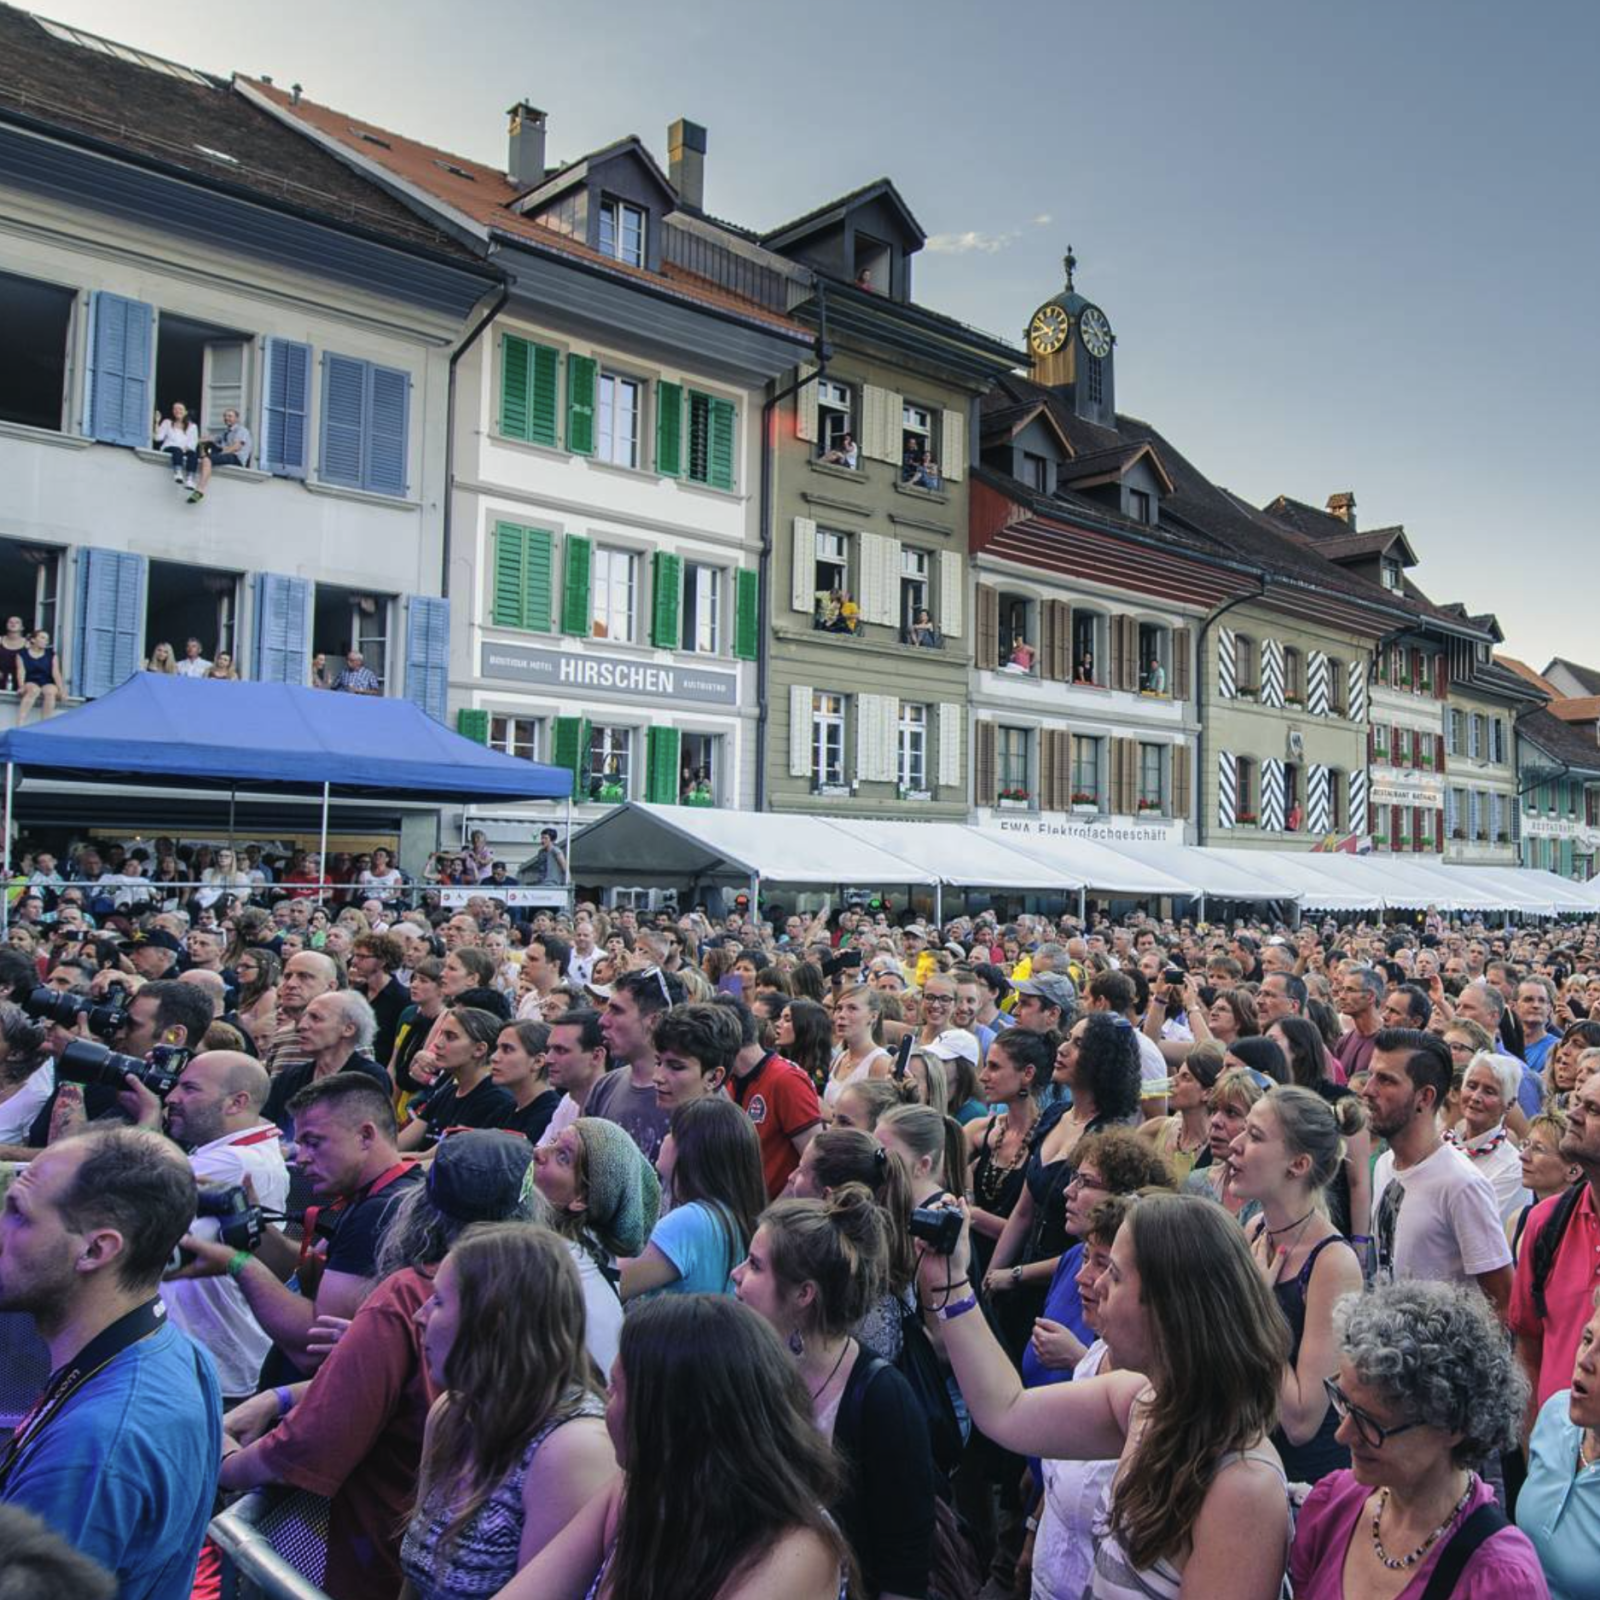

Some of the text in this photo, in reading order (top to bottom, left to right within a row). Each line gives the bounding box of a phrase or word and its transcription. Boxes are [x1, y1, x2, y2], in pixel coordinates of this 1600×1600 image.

[560, 657, 675, 693] HIRSCHEN
[1000, 821, 1167, 841] EWA Elektrofachgeschäft
